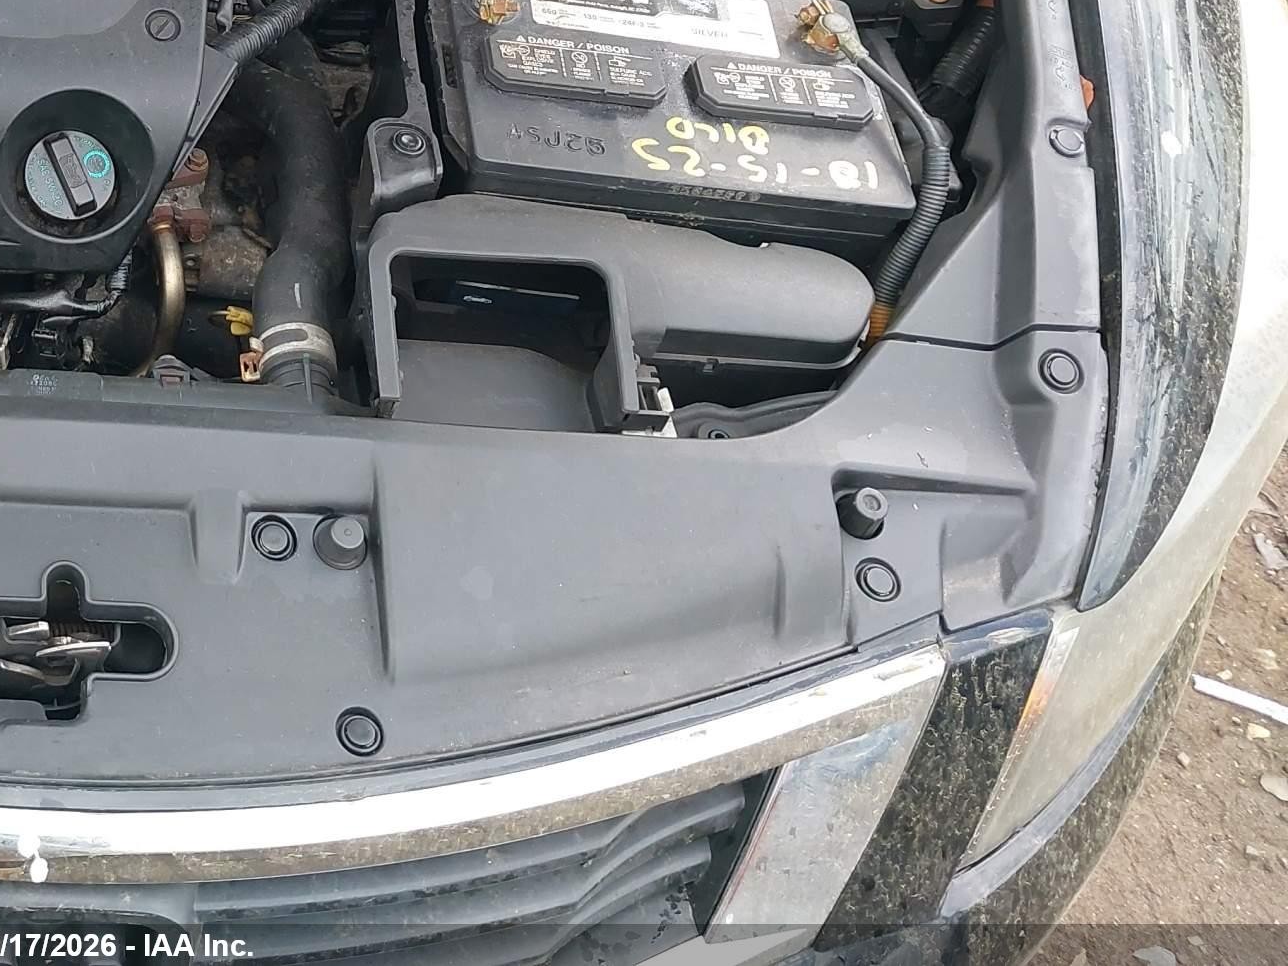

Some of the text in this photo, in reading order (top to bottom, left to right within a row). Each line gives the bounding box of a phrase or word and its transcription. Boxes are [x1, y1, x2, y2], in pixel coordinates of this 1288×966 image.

[527, 35, 574, 49] DANGER
[586, 40, 630, 54] POISON
[737, 62, 782, 74] DANGER
[792, 67, 832, 78] POISON
